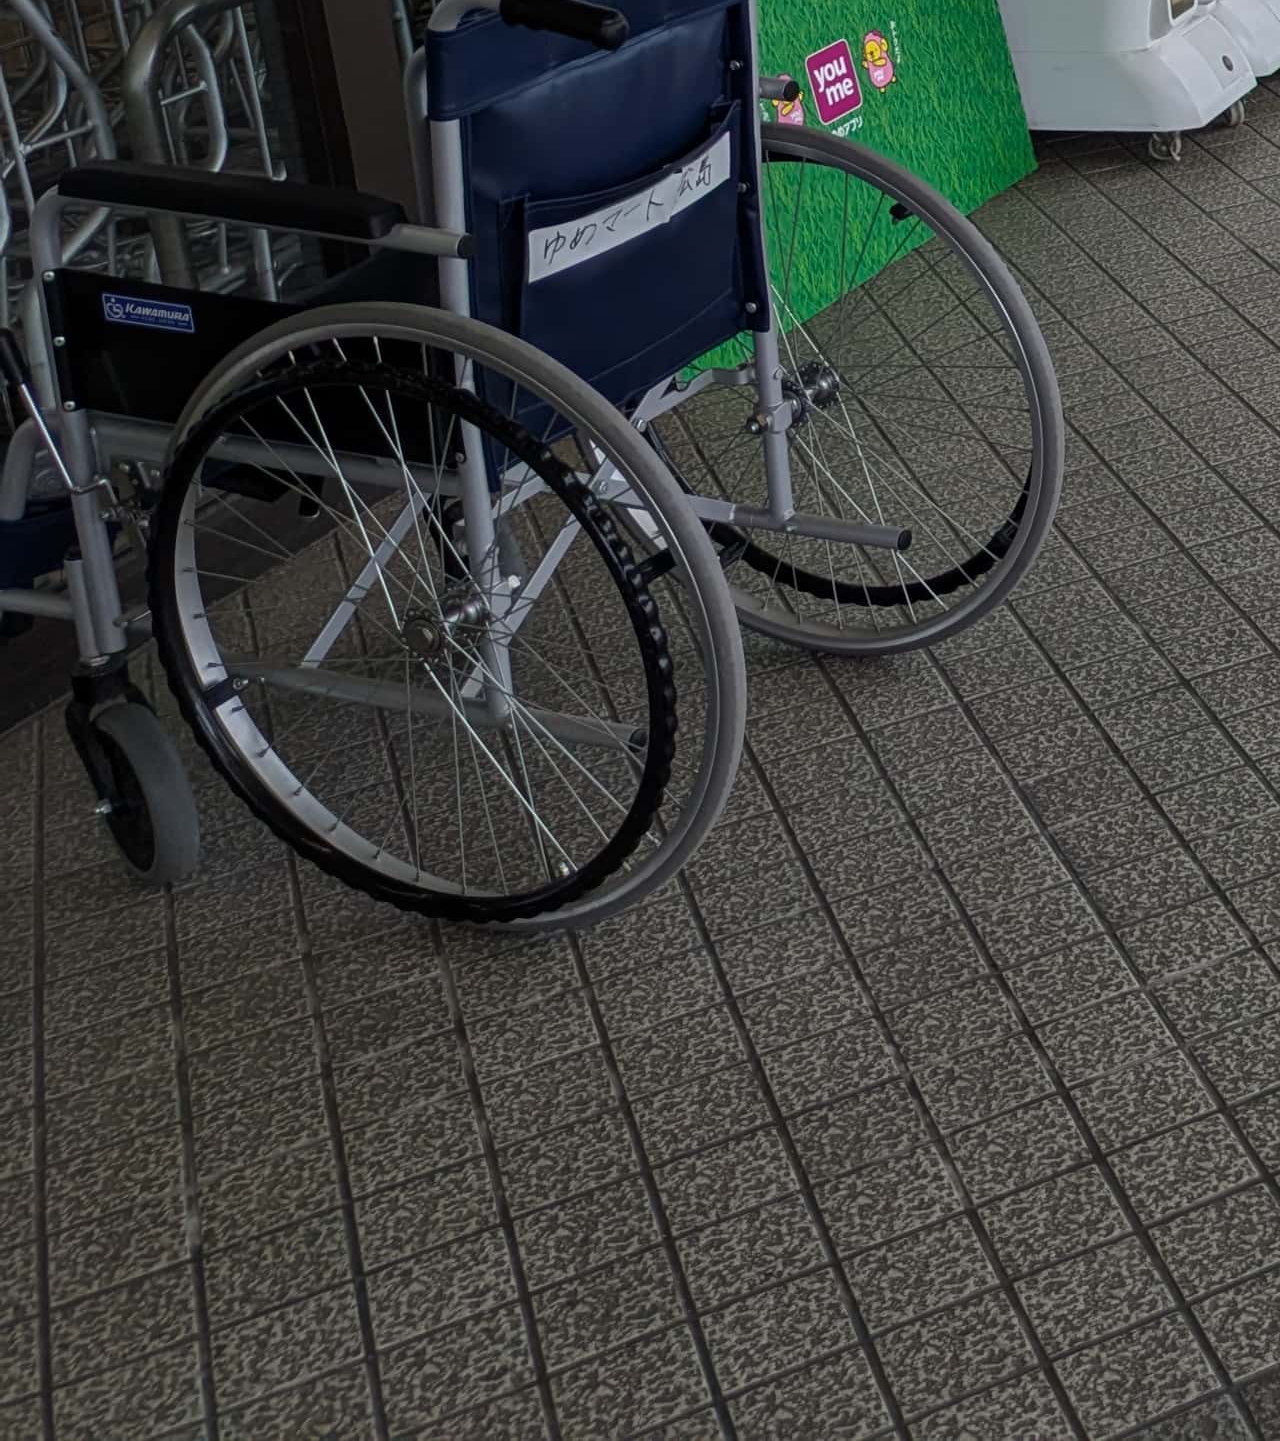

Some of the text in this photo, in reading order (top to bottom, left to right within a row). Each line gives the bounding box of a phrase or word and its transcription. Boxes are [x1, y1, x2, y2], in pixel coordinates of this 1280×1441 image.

[813, 56, 848, 94] you
[825, 77, 854, 106] me
[125, 303, 190, 322] KAWAMURA
